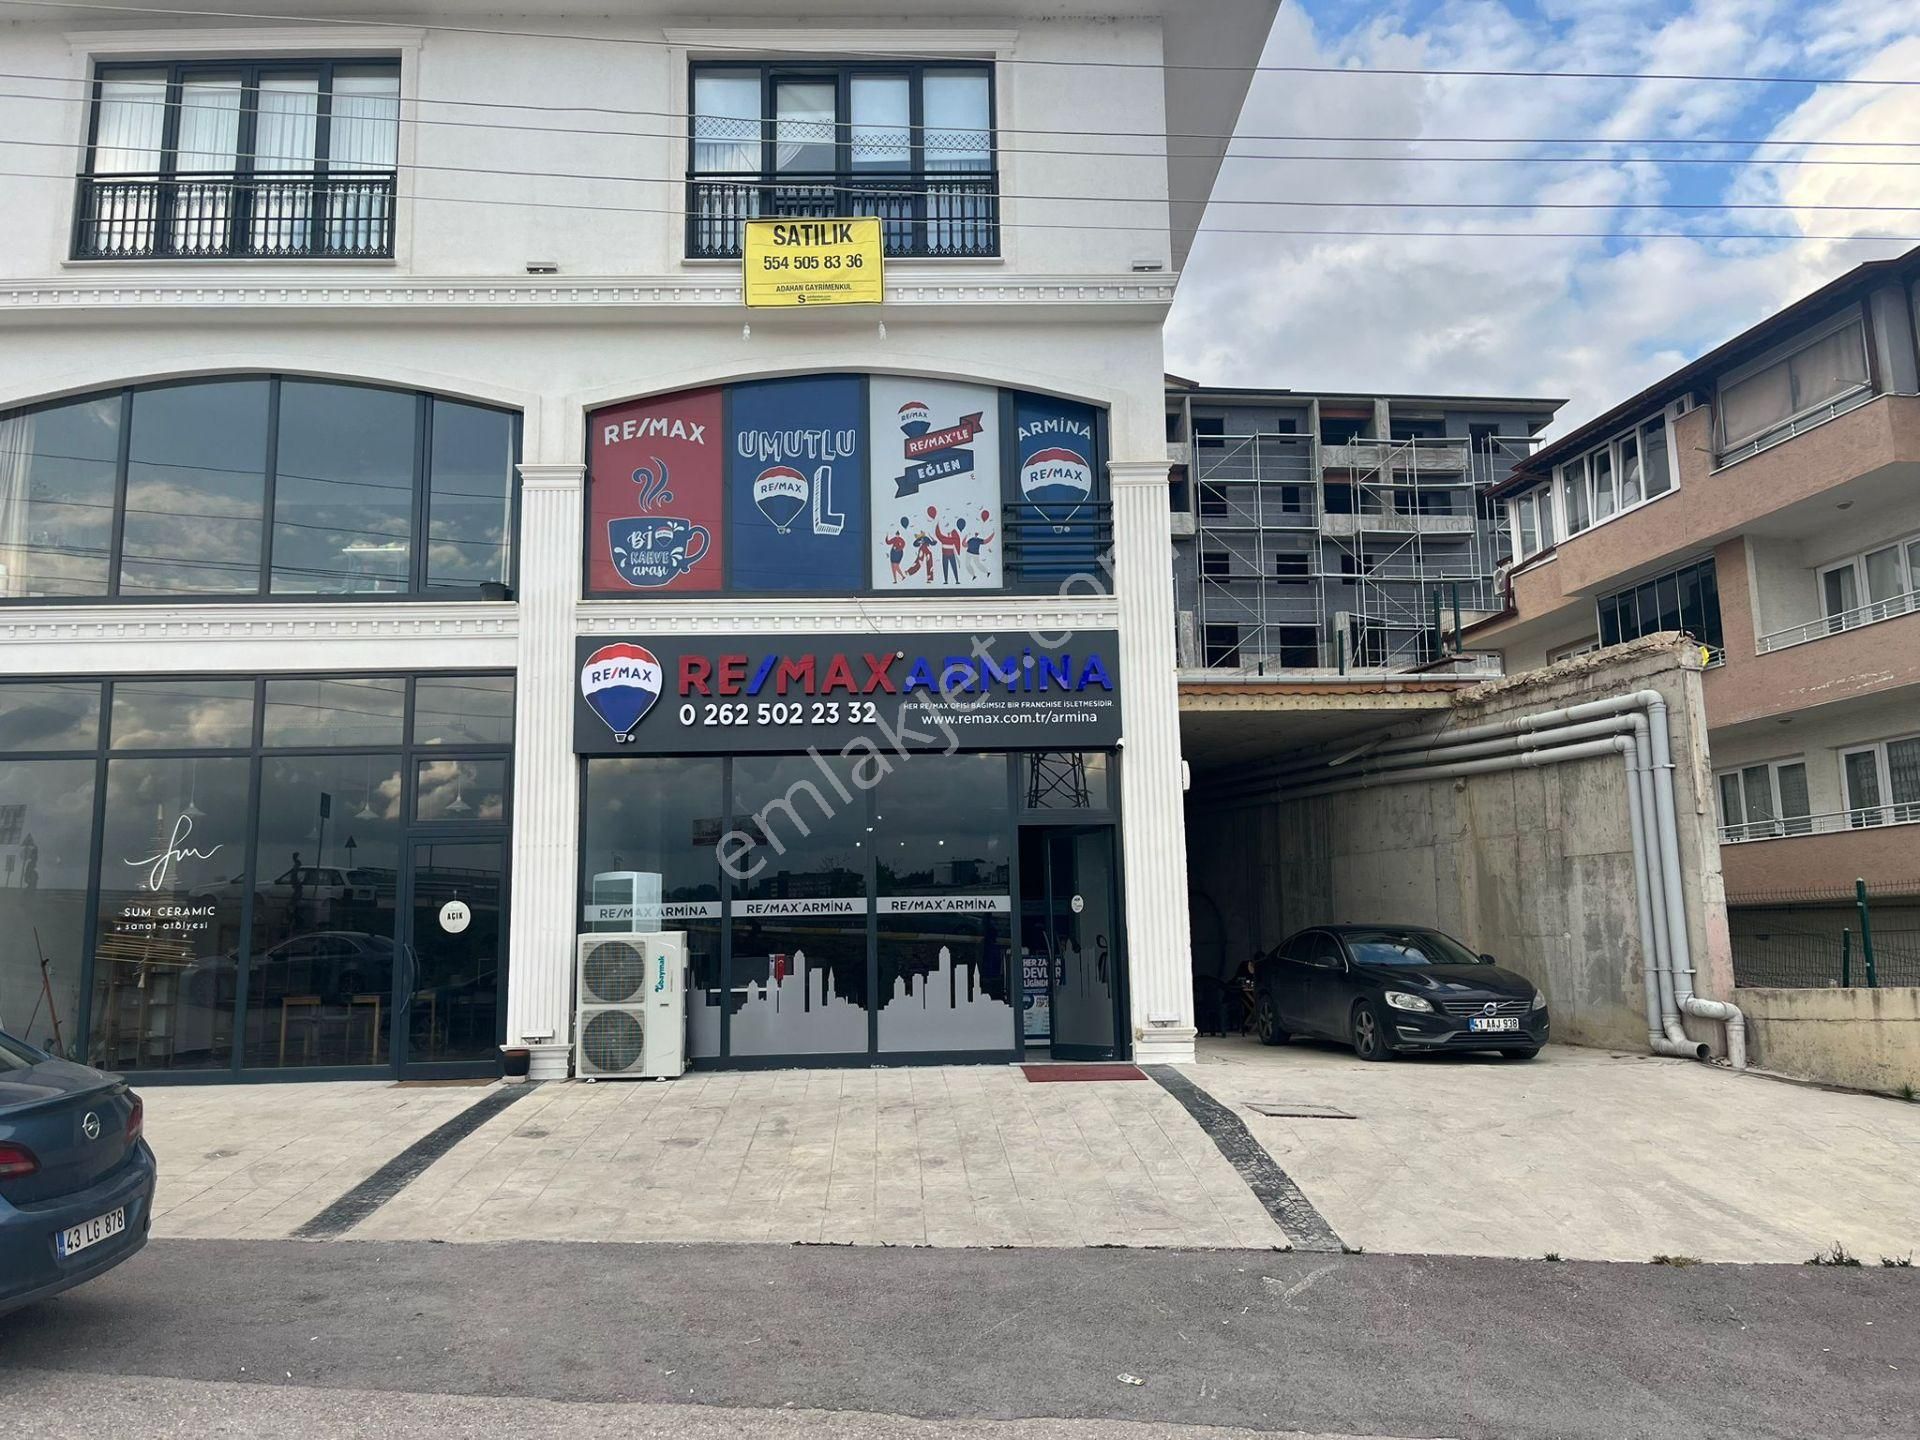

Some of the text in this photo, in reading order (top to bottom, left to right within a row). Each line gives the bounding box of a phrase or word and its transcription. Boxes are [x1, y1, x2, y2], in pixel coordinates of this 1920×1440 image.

[773, 223, 853, 246] SATILIK
[764, 253, 863, 270] 554 505 83 36
[901, 411, 928, 421] RE/MAX
[604, 417, 706, 446] RE/MAX
[1018, 417, 1091, 441] ARMİNA
[738, 429, 856, 462] UMUTLU
[909, 429, 969, 452] RE/MAX'LE
[917, 459, 961, 479] EĞLEN
[1030, 468, 1083, 483] RE/MAX
[760, 482, 802, 494] RE/MAX
[630, 550, 669, 565] KAHVE
[592, 666, 652, 684] RE/MAX
[677, 647, 1114, 697] RE/MAX ARMİNA
[679, 701, 878, 726] 0 262 502 23 32
[920, 702, 949, 710] RE/MAX
[921, 710, 1097, 724] www.remax.com.tr/armina
[124, 906, 216, 917] SUM CERAMIC
[746, 899, 854, 914] RE/MAX ARMİNA
[891, 898, 997, 911] RE/MAX ARMİNA
[125, 921, 208, 931] sanat atölyesi
[1503, 1019, 1518, 1028] 938
[67, 1210, 123, 1250] 43 LG 878
